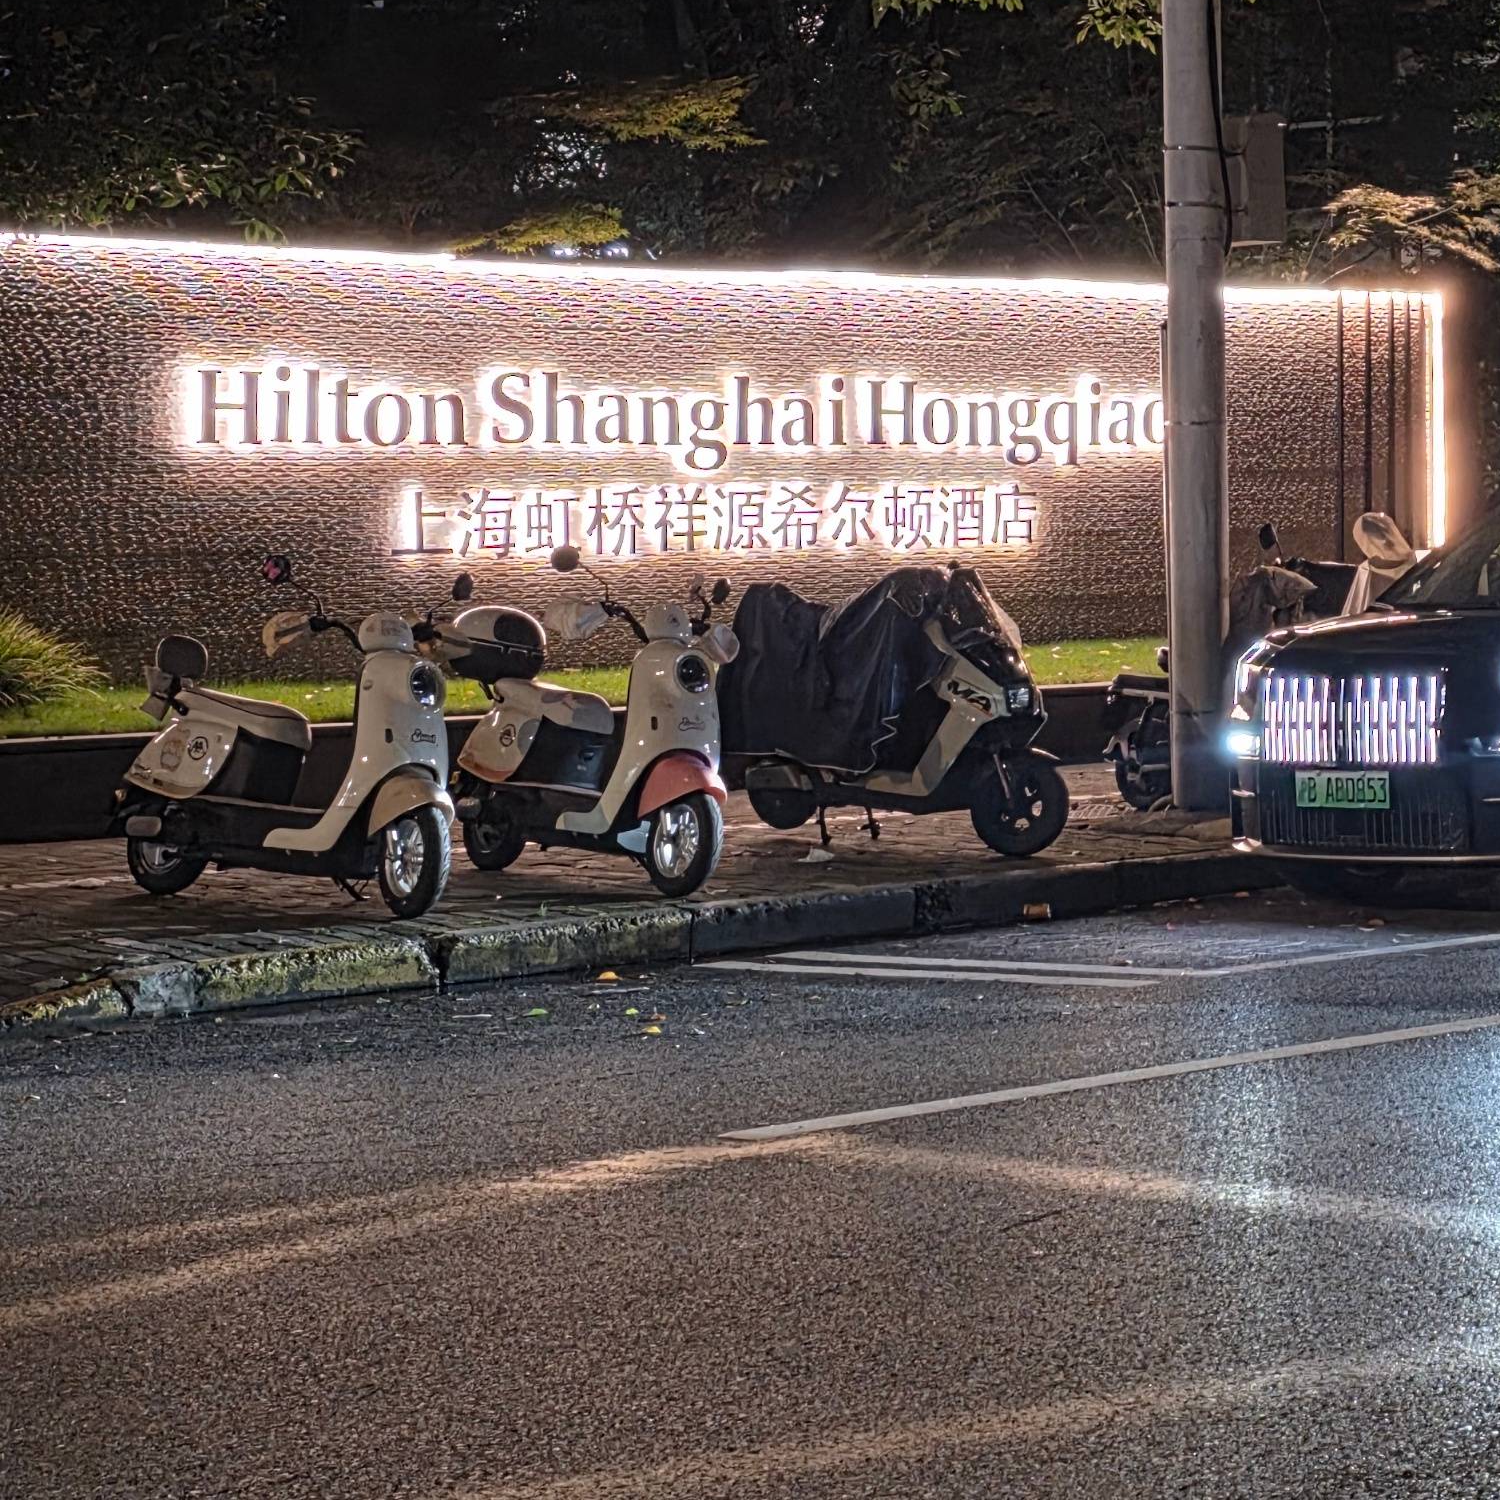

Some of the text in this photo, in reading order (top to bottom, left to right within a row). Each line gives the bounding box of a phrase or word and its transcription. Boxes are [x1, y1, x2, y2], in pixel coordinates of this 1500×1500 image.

[196, 366, 469, 447] Hilton
[490, 371, 847, 471] Shanghai
[391, 486, 1038, 556] 上海虹桥祥源希尔顿酒店
